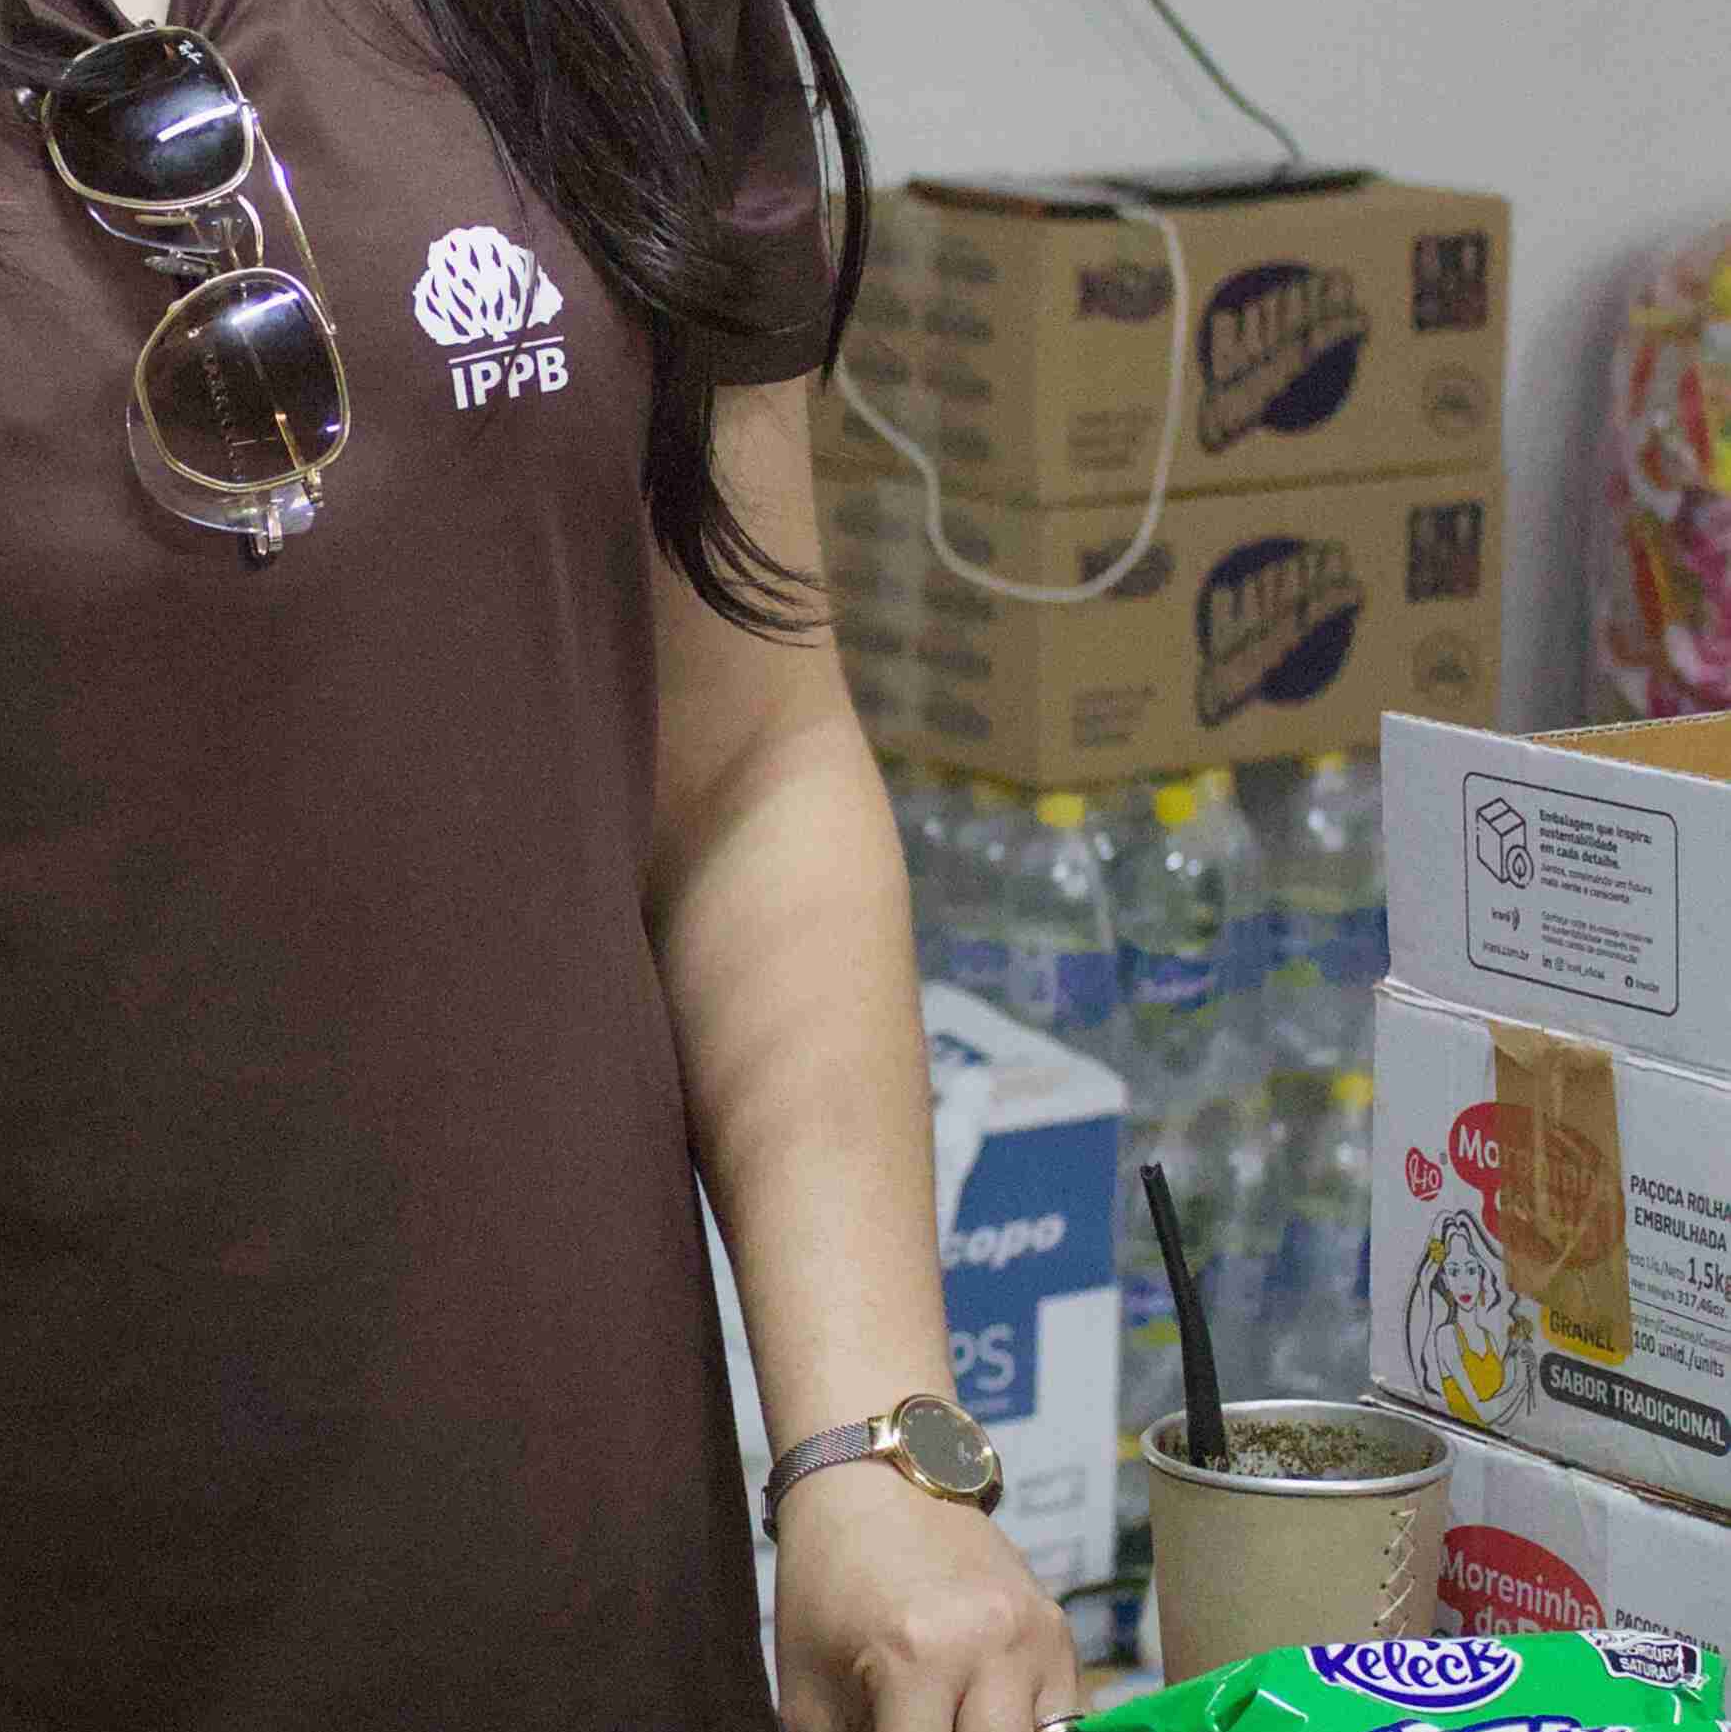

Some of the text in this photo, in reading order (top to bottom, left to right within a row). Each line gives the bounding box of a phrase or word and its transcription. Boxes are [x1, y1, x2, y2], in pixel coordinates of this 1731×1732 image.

[452, 347, 569, 410] IPPB
[1556, 845, 1579, 861] cada
[1630, 1175, 1684, 1208] PAÇOCA
[1633, 1207, 1727, 1253] EMBRULHADA
[1549, 1310, 1615, 1353] GRANEL
[1633, 1330, 1655, 1355] 100
[1550, 1365, 1726, 1446] SABOR TRADICIONAL
[1438, 1543, 1599, 1630] Moreninha
[1307, 1639, 1517, 1709] Keleck
